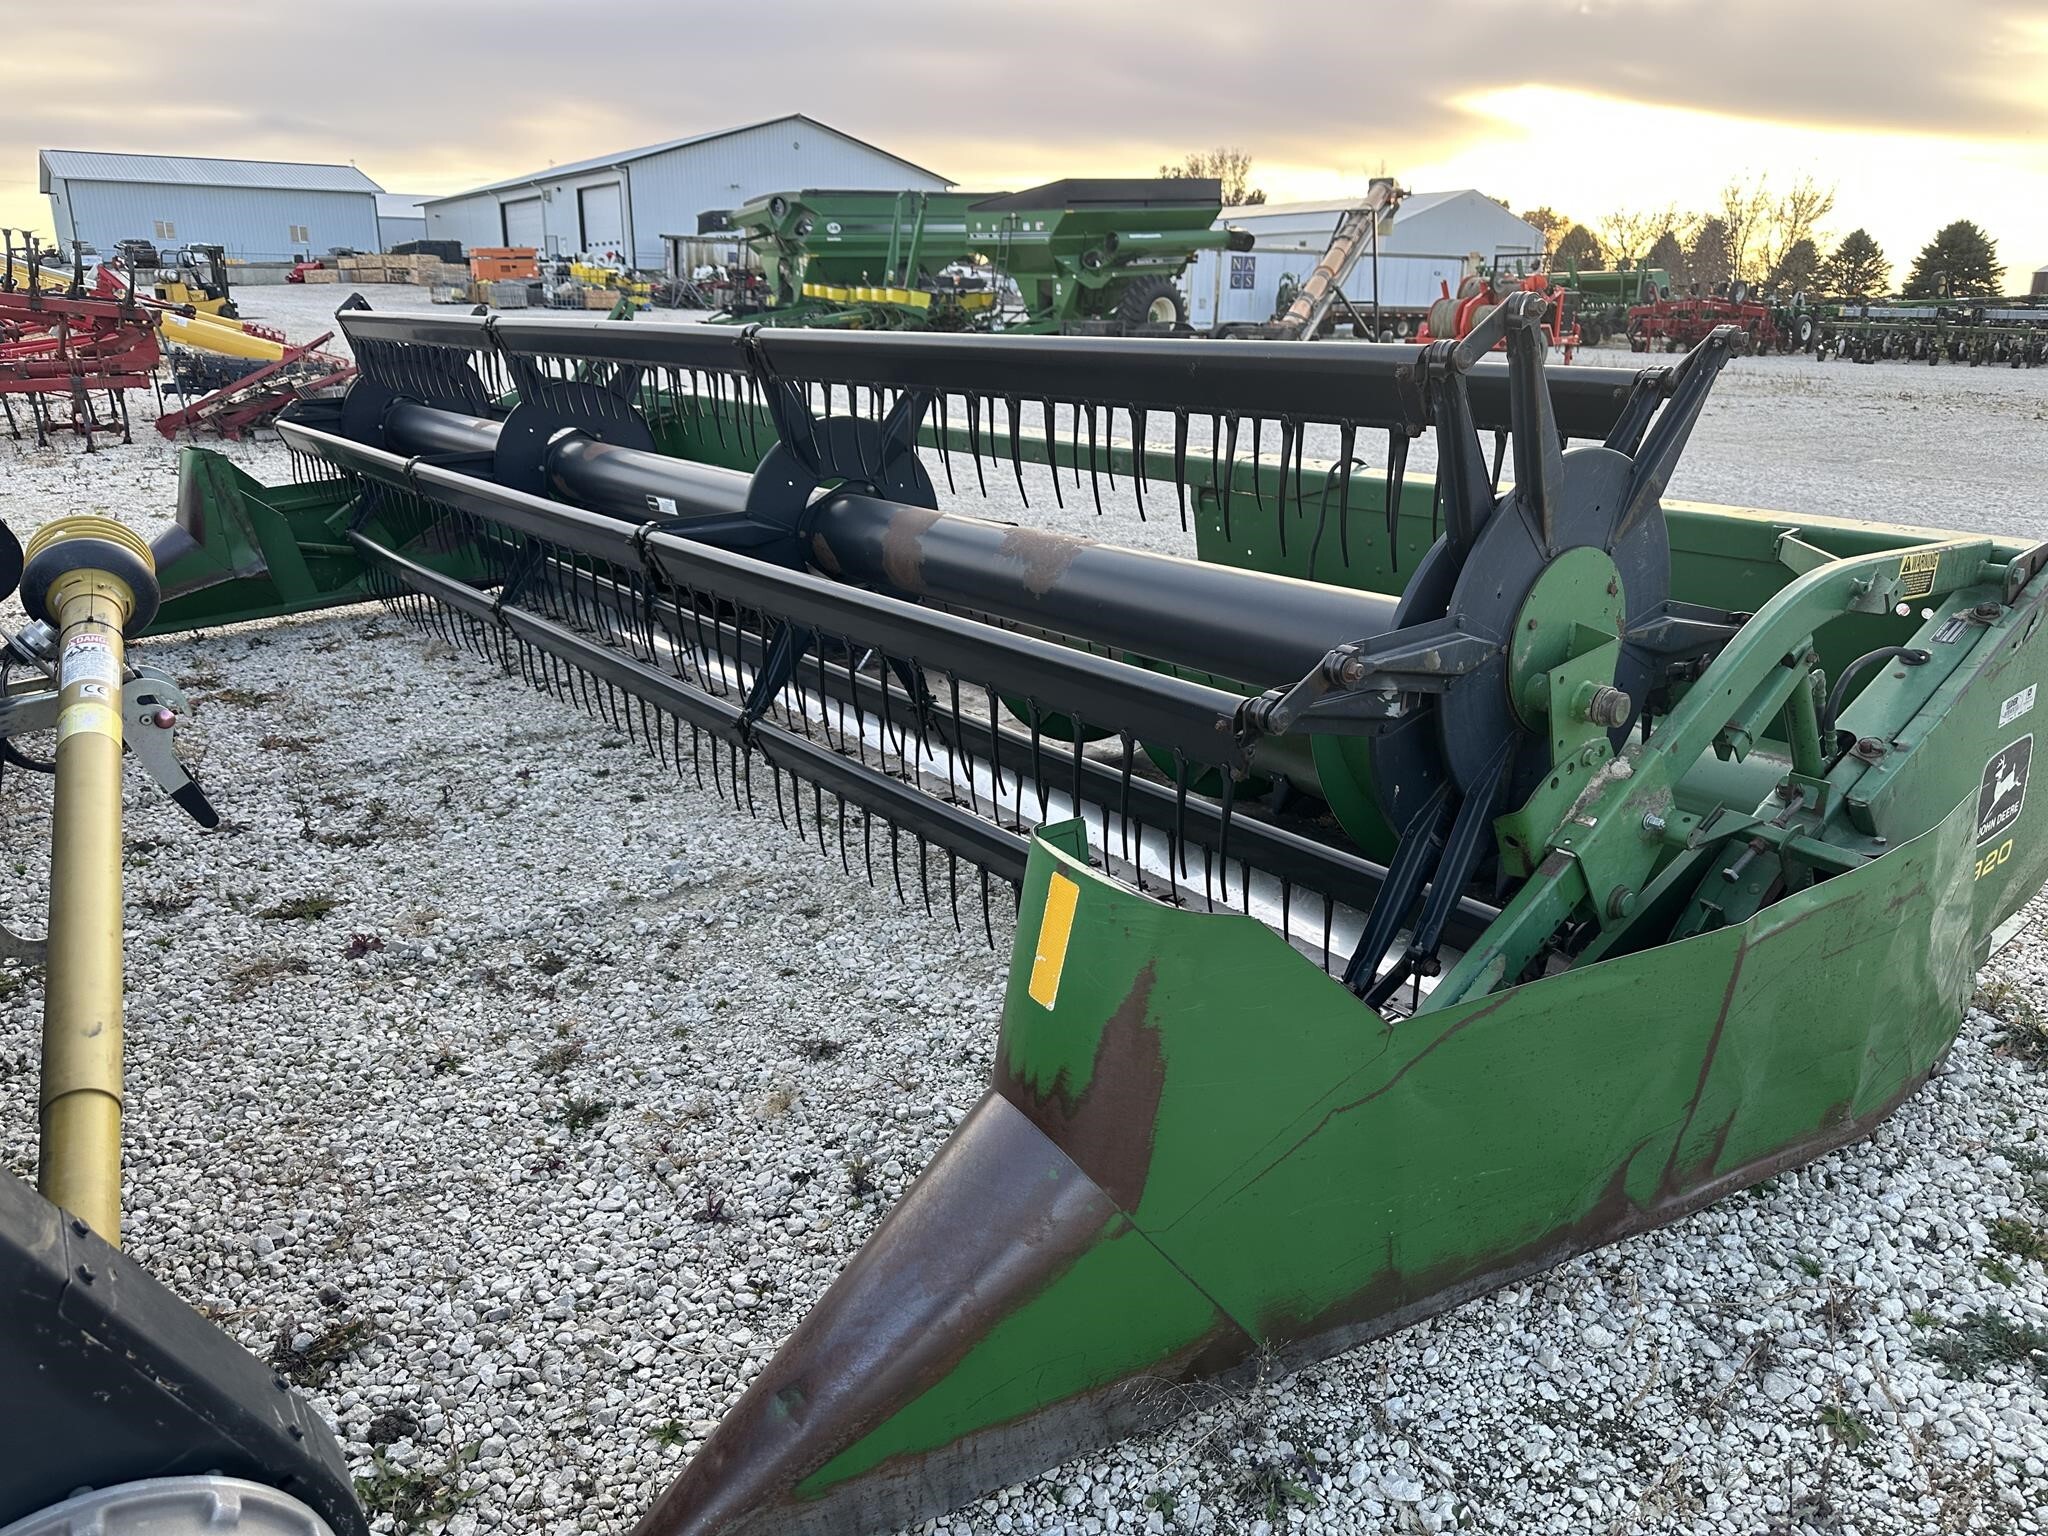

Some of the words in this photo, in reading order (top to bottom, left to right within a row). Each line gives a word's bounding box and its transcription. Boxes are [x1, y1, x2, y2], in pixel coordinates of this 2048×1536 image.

[1911, 552, 1938, 570] WARNING
[1977, 817, 1997, 839] JOHN
[1996, 801, 2020, 825] DEERE
